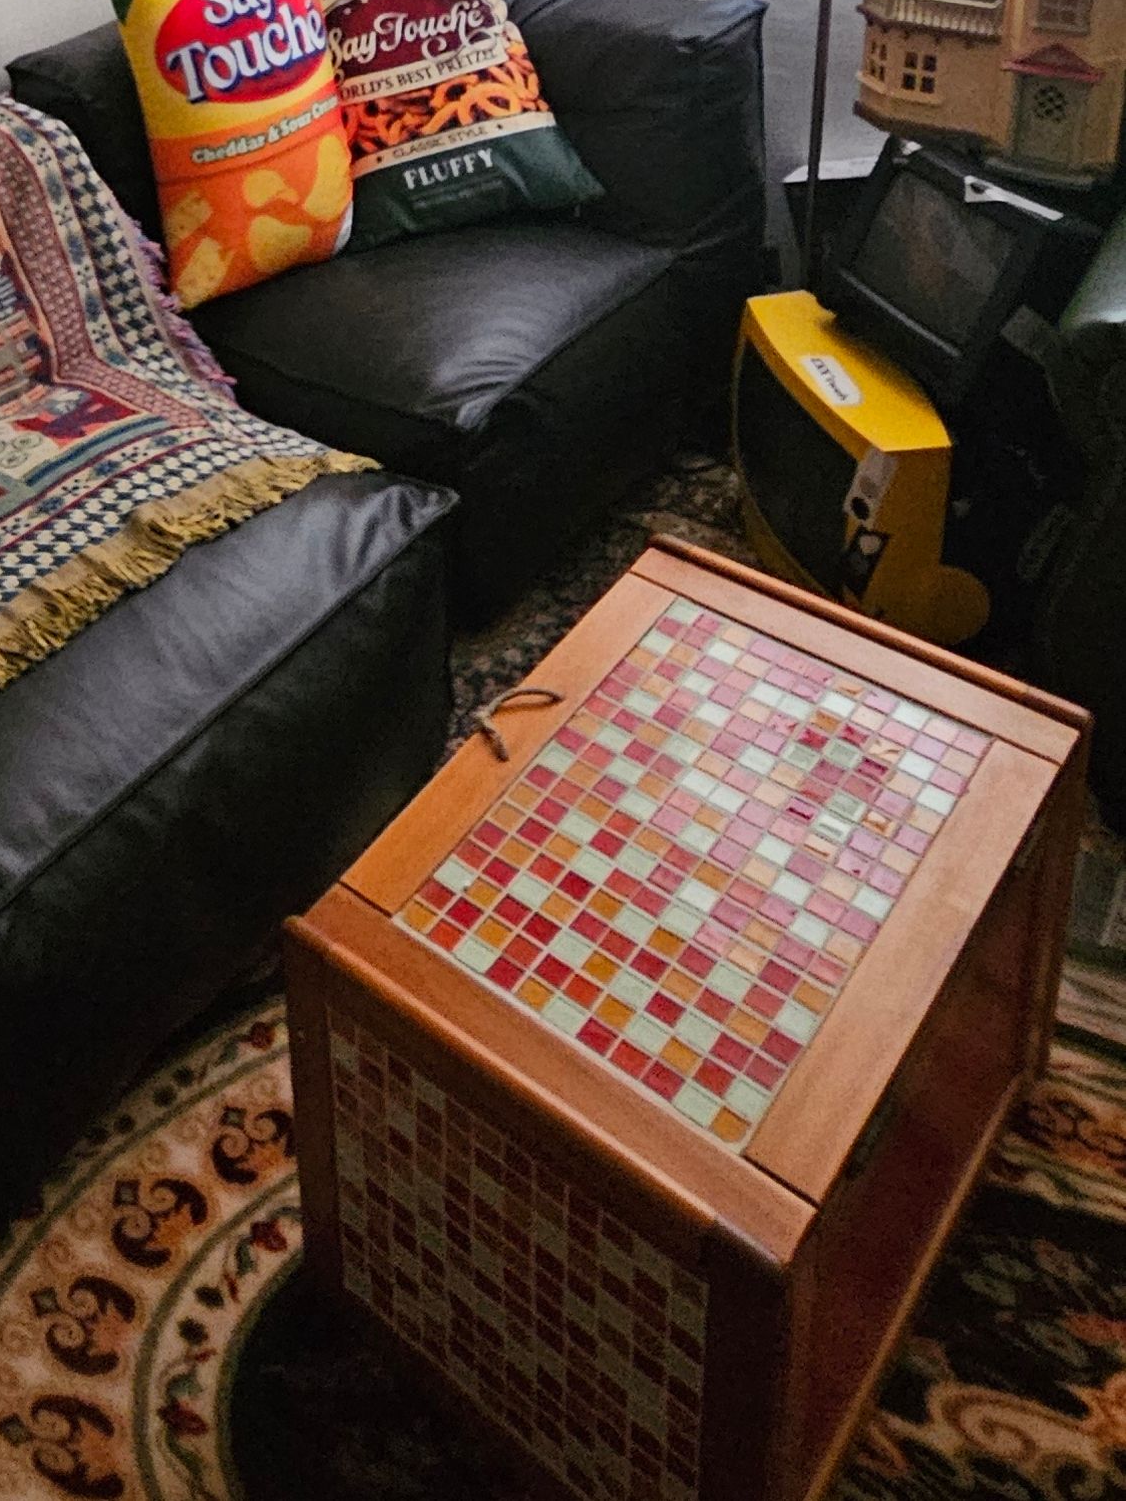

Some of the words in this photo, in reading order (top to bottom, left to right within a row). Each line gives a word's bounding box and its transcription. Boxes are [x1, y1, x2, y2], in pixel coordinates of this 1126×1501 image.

[329, 27, 377, 82] Say
[374, 0, 494, 60] Touché
[340, 75, 393, 99] ORLD'S
[396, 65, 431, 85] BEST
[191, 133, 266, 163] Cheddar
[447, 126, 488, 144] STYLE
[403, 147, 494, 190] FLUFFY
